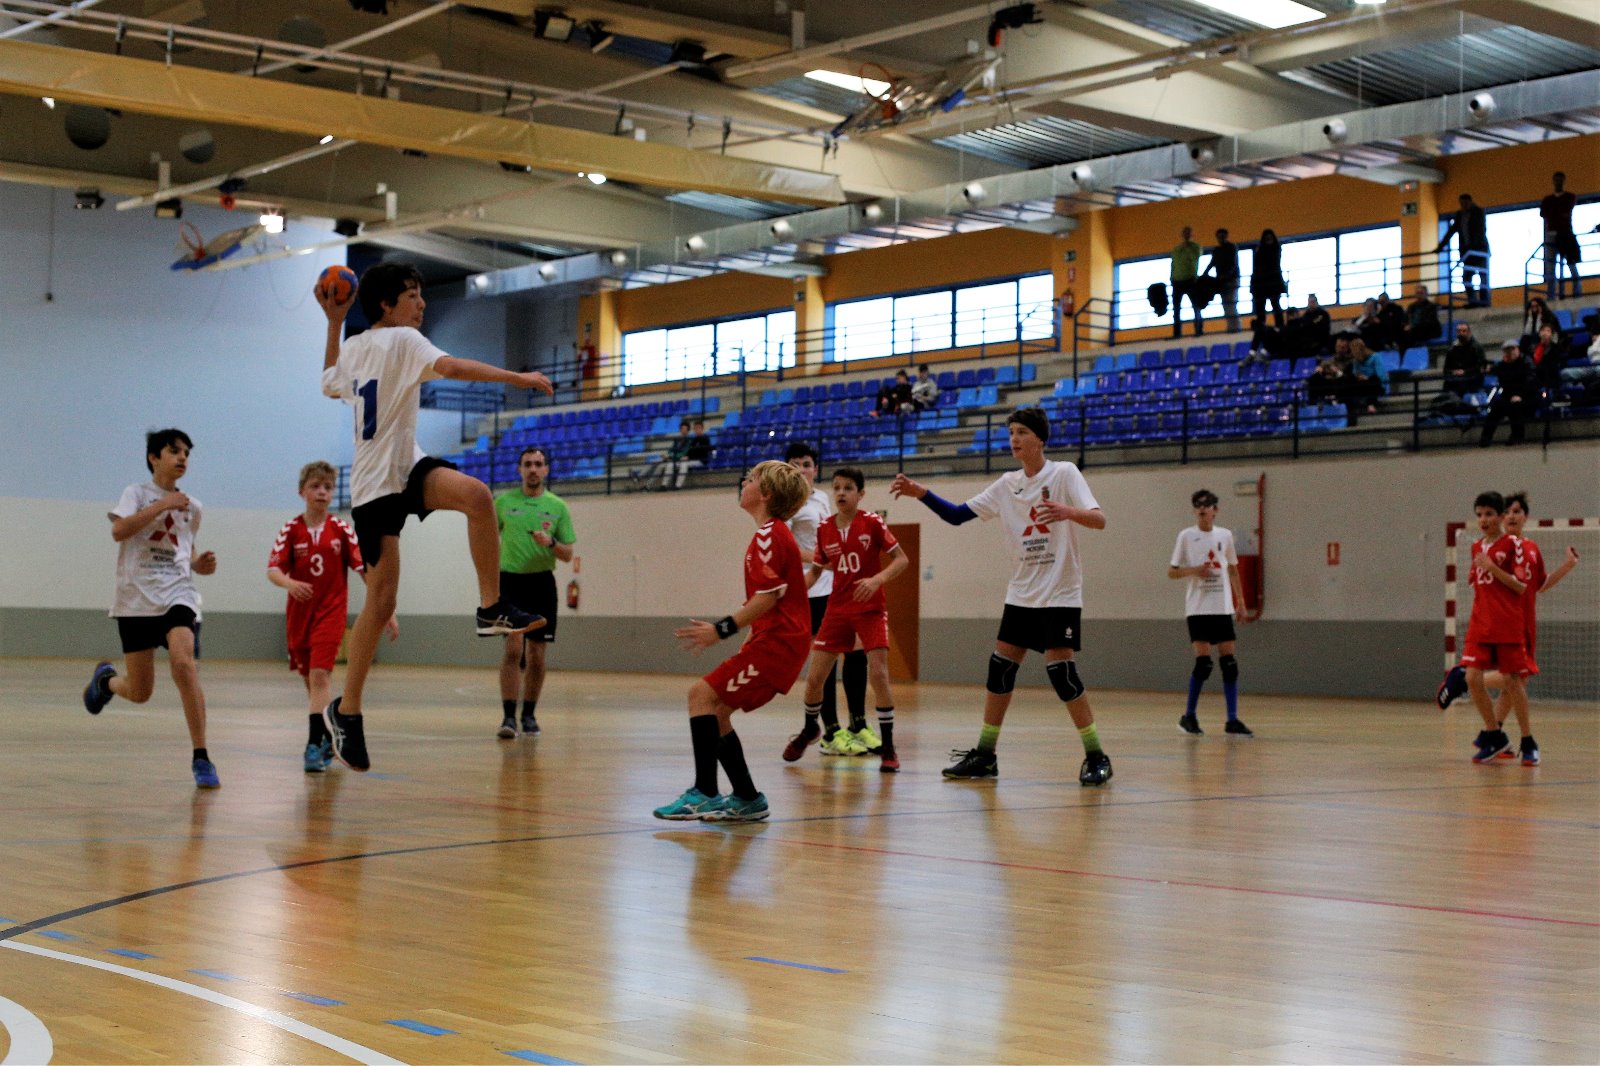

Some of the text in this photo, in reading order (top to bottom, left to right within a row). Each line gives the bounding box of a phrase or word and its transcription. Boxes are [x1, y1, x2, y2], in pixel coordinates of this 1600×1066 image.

[353, 378, 378, 440] 1
[310, 554, 324, 577] 3
[837, 553, 861, 574] 40
[1476, 566, 1493, 584] 23
